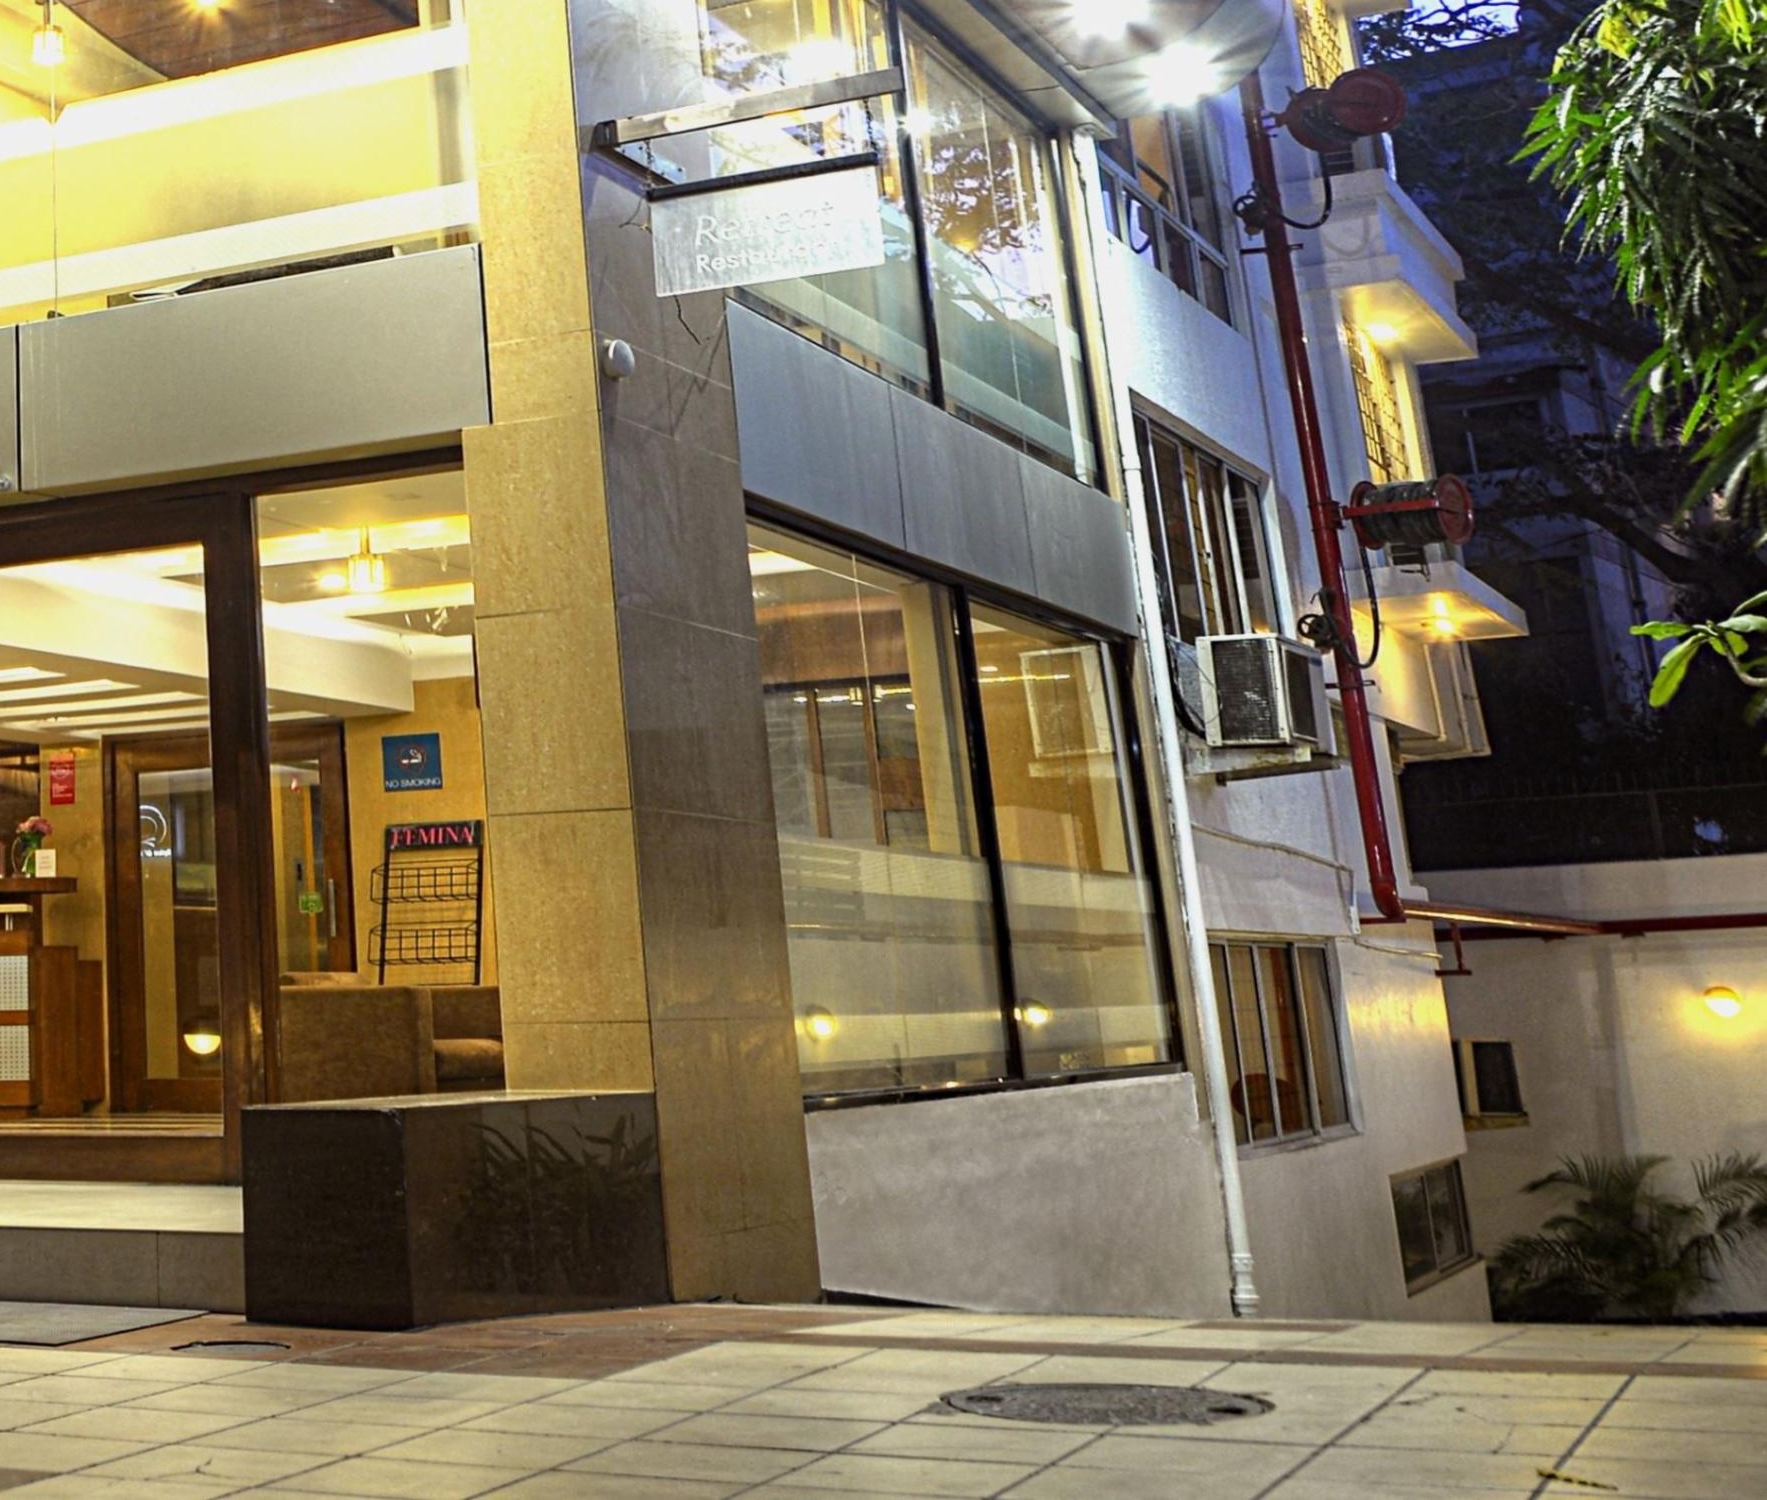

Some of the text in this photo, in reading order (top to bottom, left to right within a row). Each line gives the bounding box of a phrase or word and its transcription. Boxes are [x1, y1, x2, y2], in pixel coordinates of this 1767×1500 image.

[385, 777, 441, 788] NO SMOKING
[391, 825, 473, 846] FEMINA
